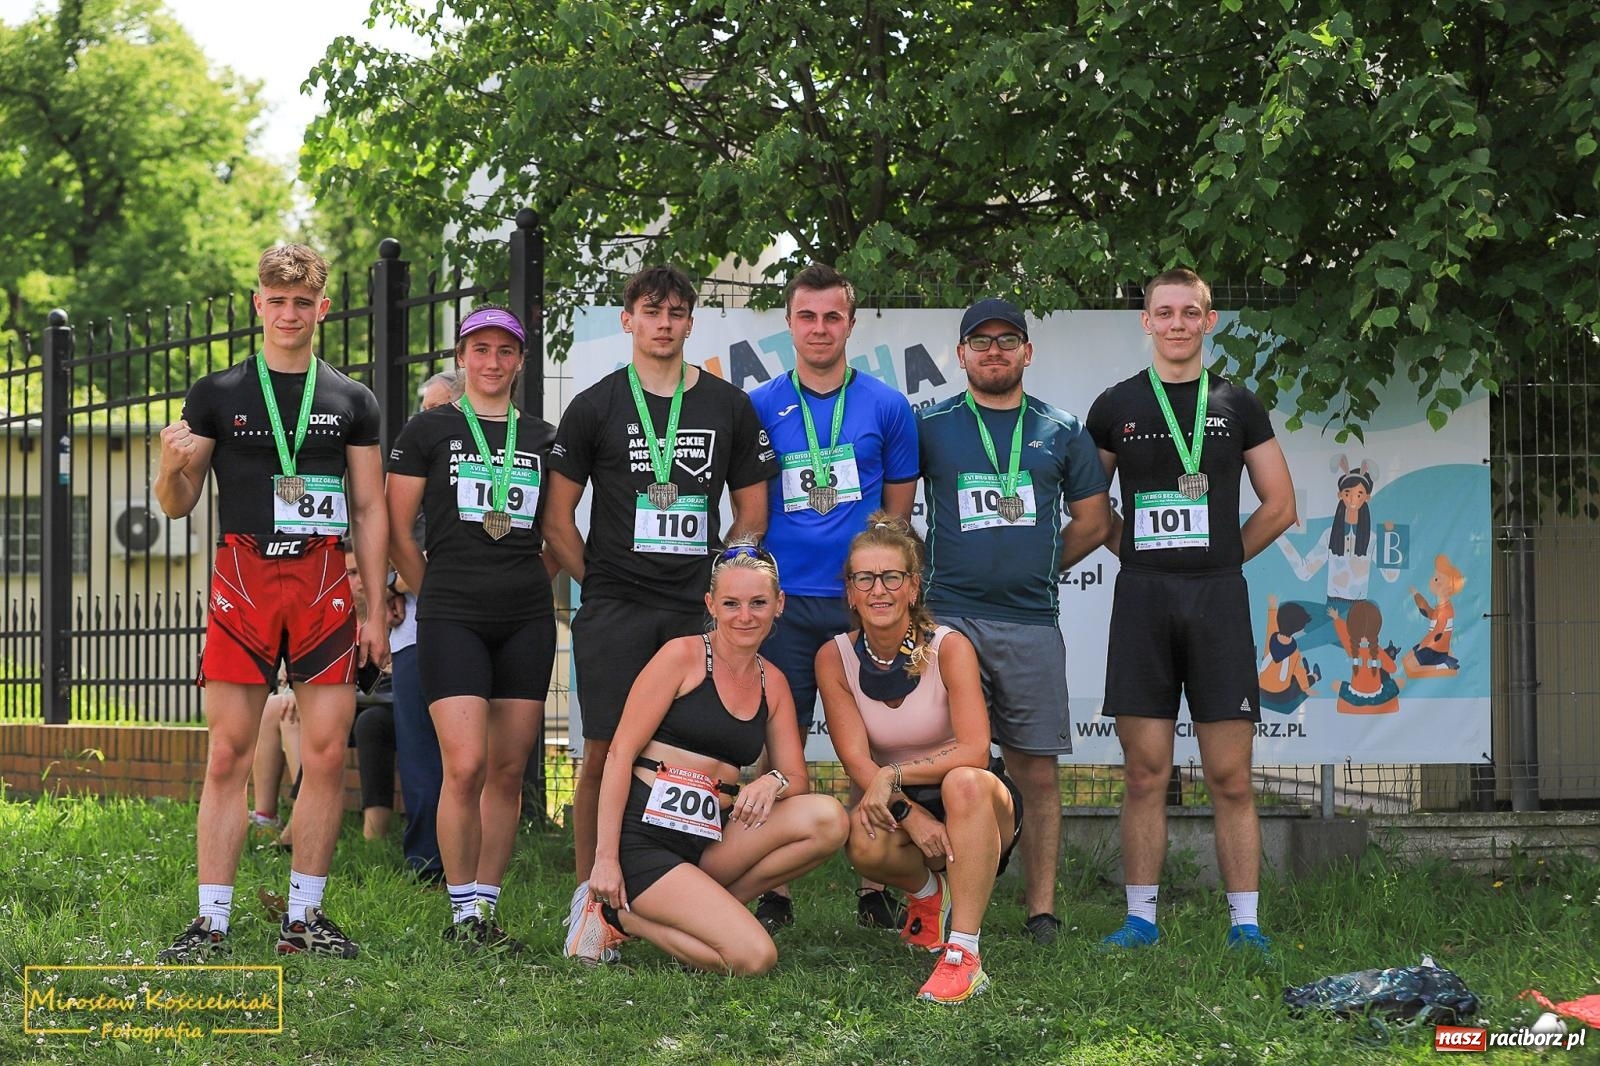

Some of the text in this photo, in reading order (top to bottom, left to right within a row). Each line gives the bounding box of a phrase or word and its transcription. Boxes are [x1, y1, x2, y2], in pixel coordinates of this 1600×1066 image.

[309, 414, 340, 426] DZIK
[1205, 417, 1228, 428] ZIK
[1123, 433, 1173, 442] SPORTOW
[298, 494, 334, 518] 84
[971, 490, 1020, 514] 10
[656, 514, 698, 538] 110
[1150, 508, 1191, 533] 101
[266, 541, 301, 556] UFC
[1384, 532, 1402, 564] B
[660, 786, 716, 820] 200
